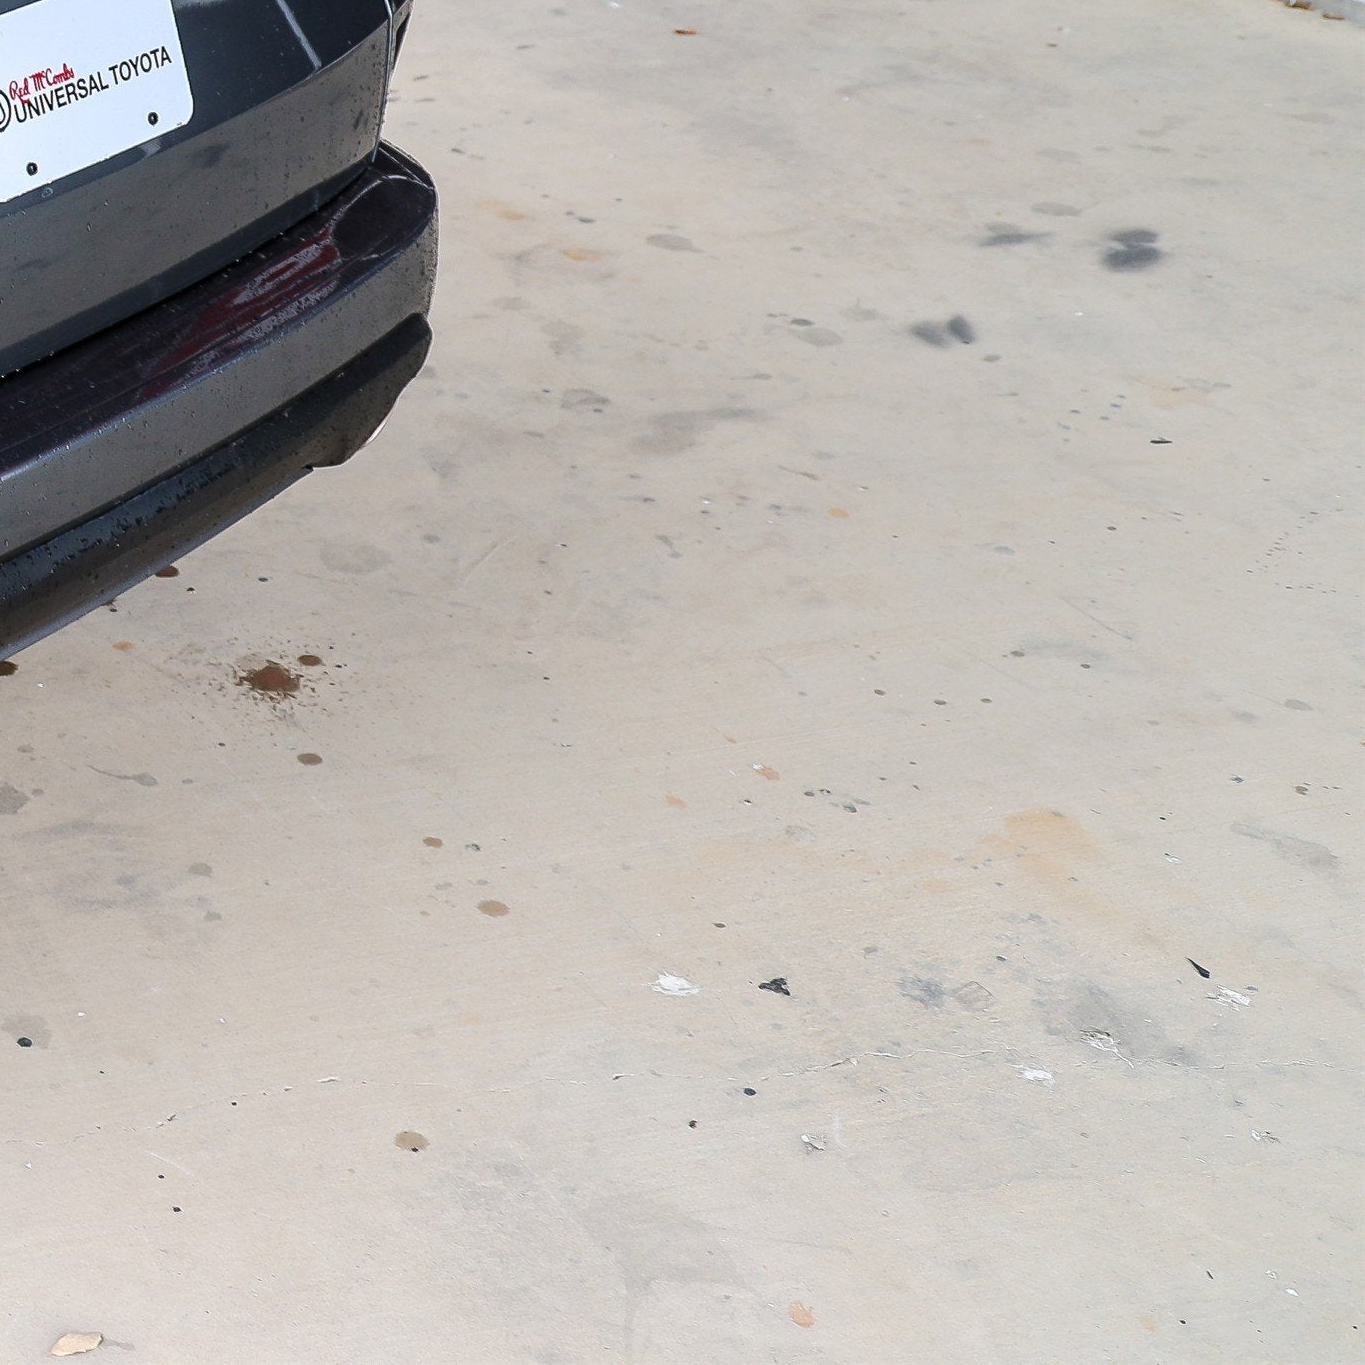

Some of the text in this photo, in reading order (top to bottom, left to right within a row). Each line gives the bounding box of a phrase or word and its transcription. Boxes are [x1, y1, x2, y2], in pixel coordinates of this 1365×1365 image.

[9, 62, 75, 103] Red McCombs
[13, 45, 173, 123] UNIVERSAL TOYOTA
